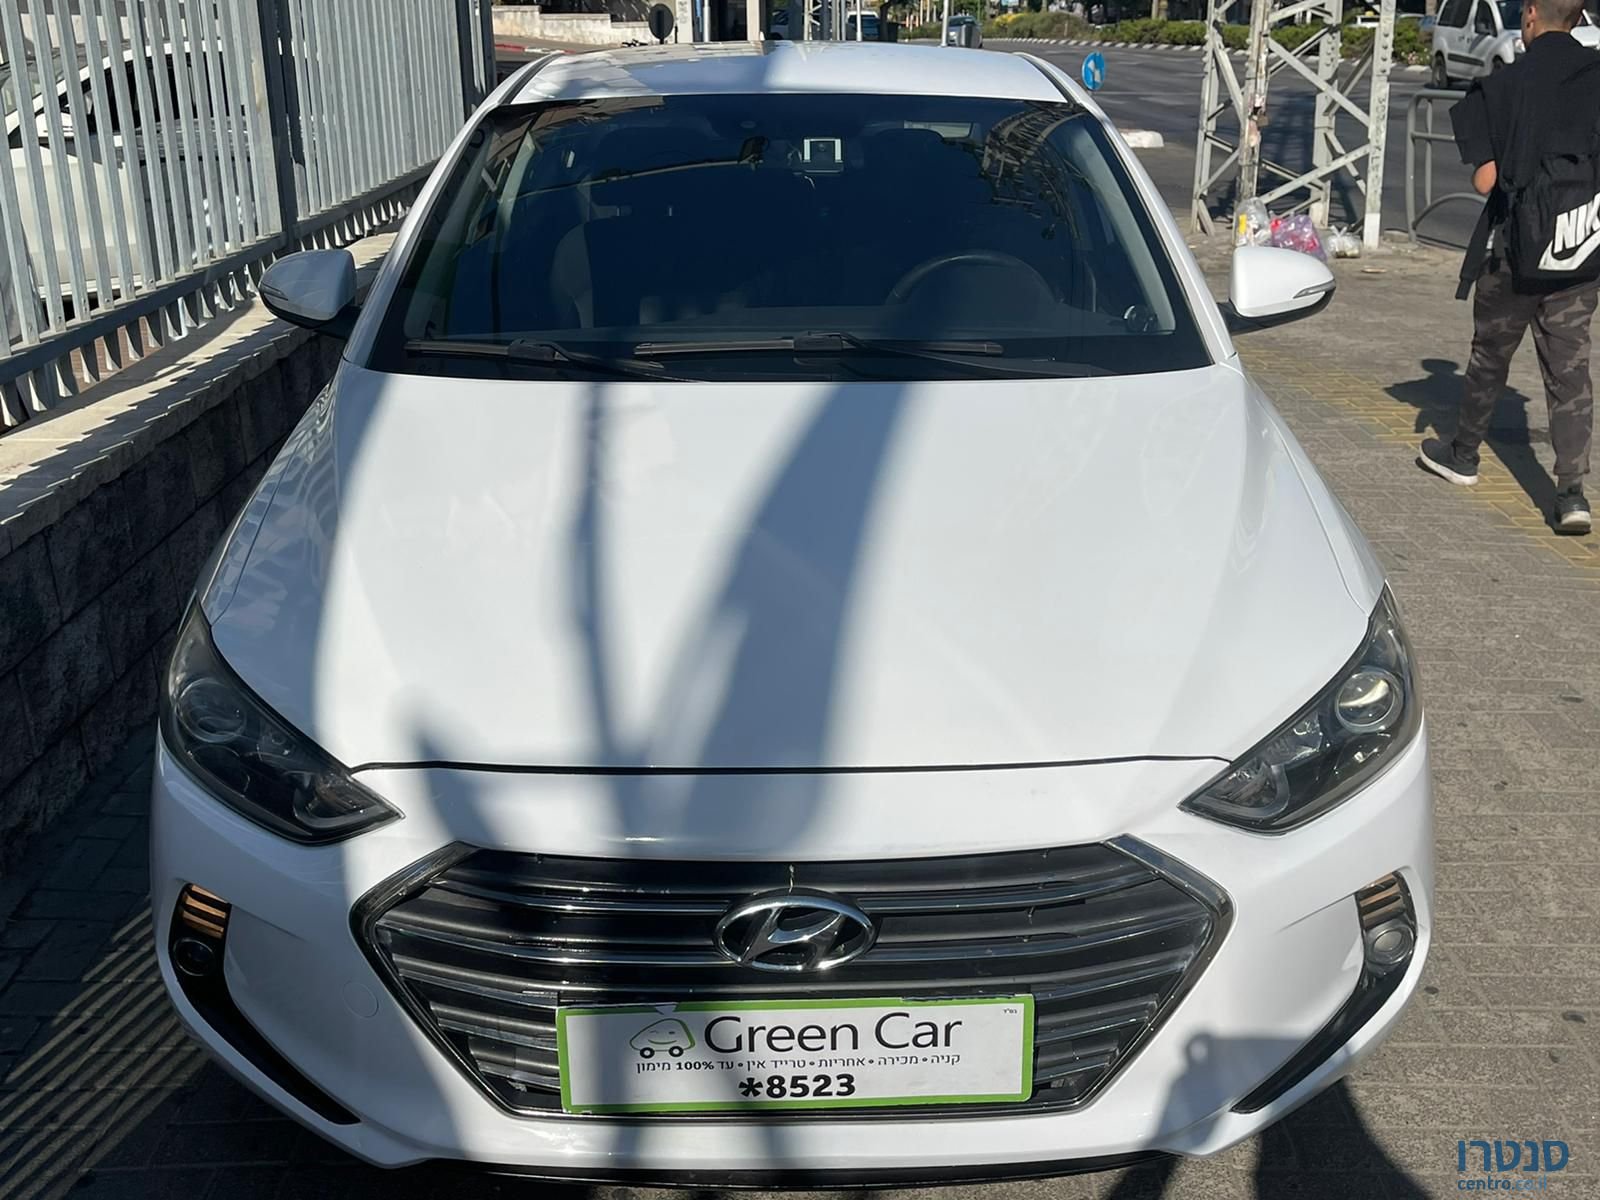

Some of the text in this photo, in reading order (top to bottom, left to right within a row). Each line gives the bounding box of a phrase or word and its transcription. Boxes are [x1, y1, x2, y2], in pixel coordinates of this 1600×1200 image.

[1553, 192, 1600, 254] NIK
[704, 1011, 963, 1054] Green Car
[636, 1053, 961, 1074] קניה מכירה אחריות טרייד אין עד 100% מימון
